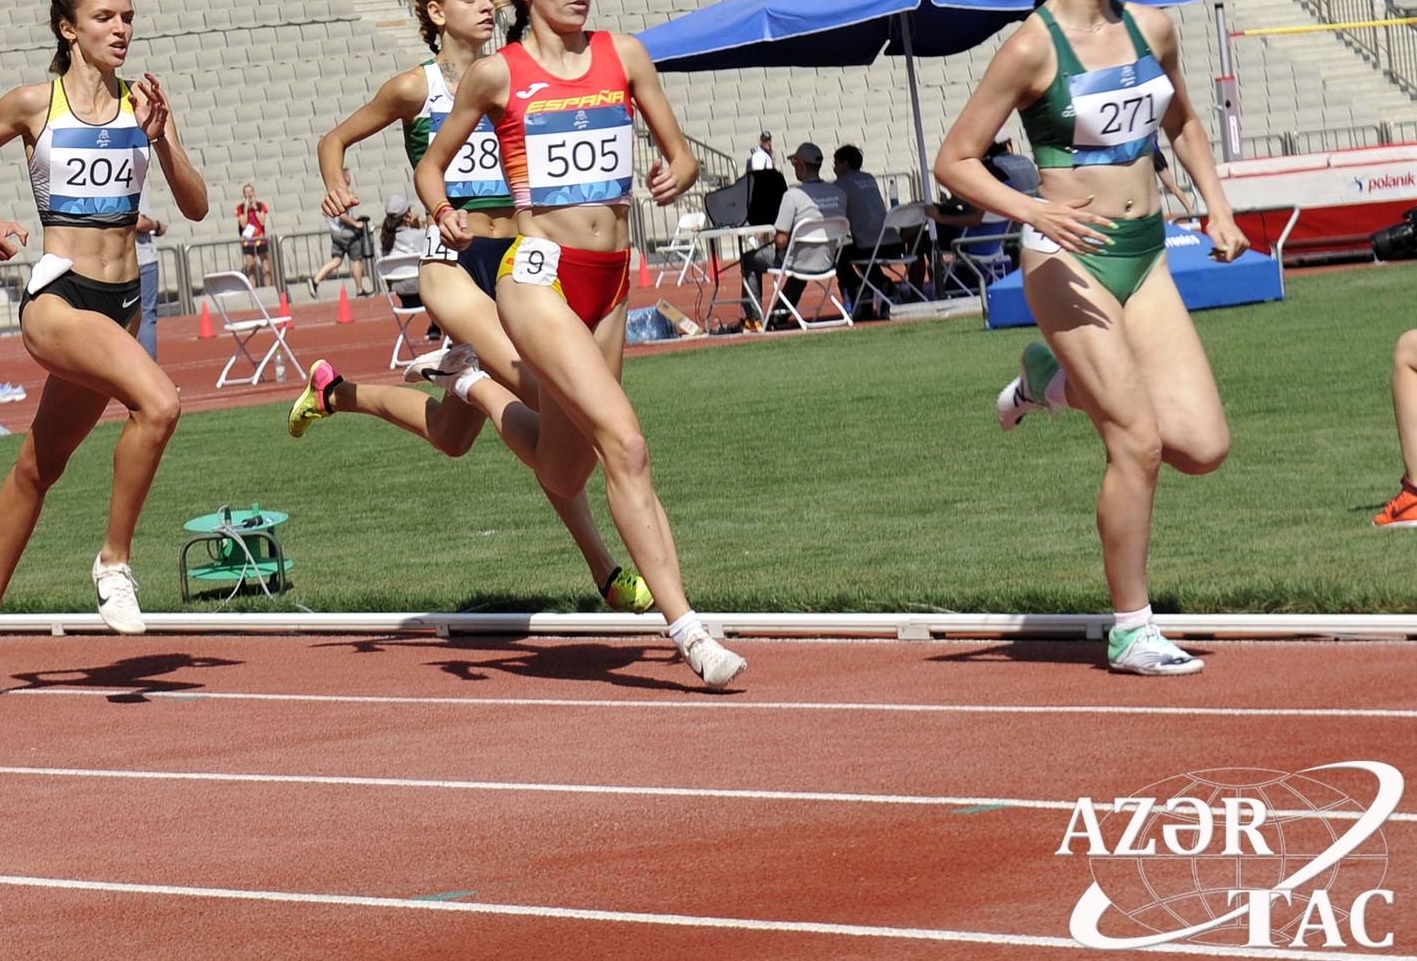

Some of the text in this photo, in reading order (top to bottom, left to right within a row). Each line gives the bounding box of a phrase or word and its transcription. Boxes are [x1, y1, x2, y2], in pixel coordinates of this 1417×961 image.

[526, 90, 625, 113] ESPAÑA
[1100, 93, 1157, 135] 271
[458, 138, 498, 174] 38
[547, 134, 619, 178] 505
[66, 157, 134, 188] 204
[1368, 171, 1415, 194] polanik
[425, 236, 451, 260] 14
[526, 250, 545, 274] 9
